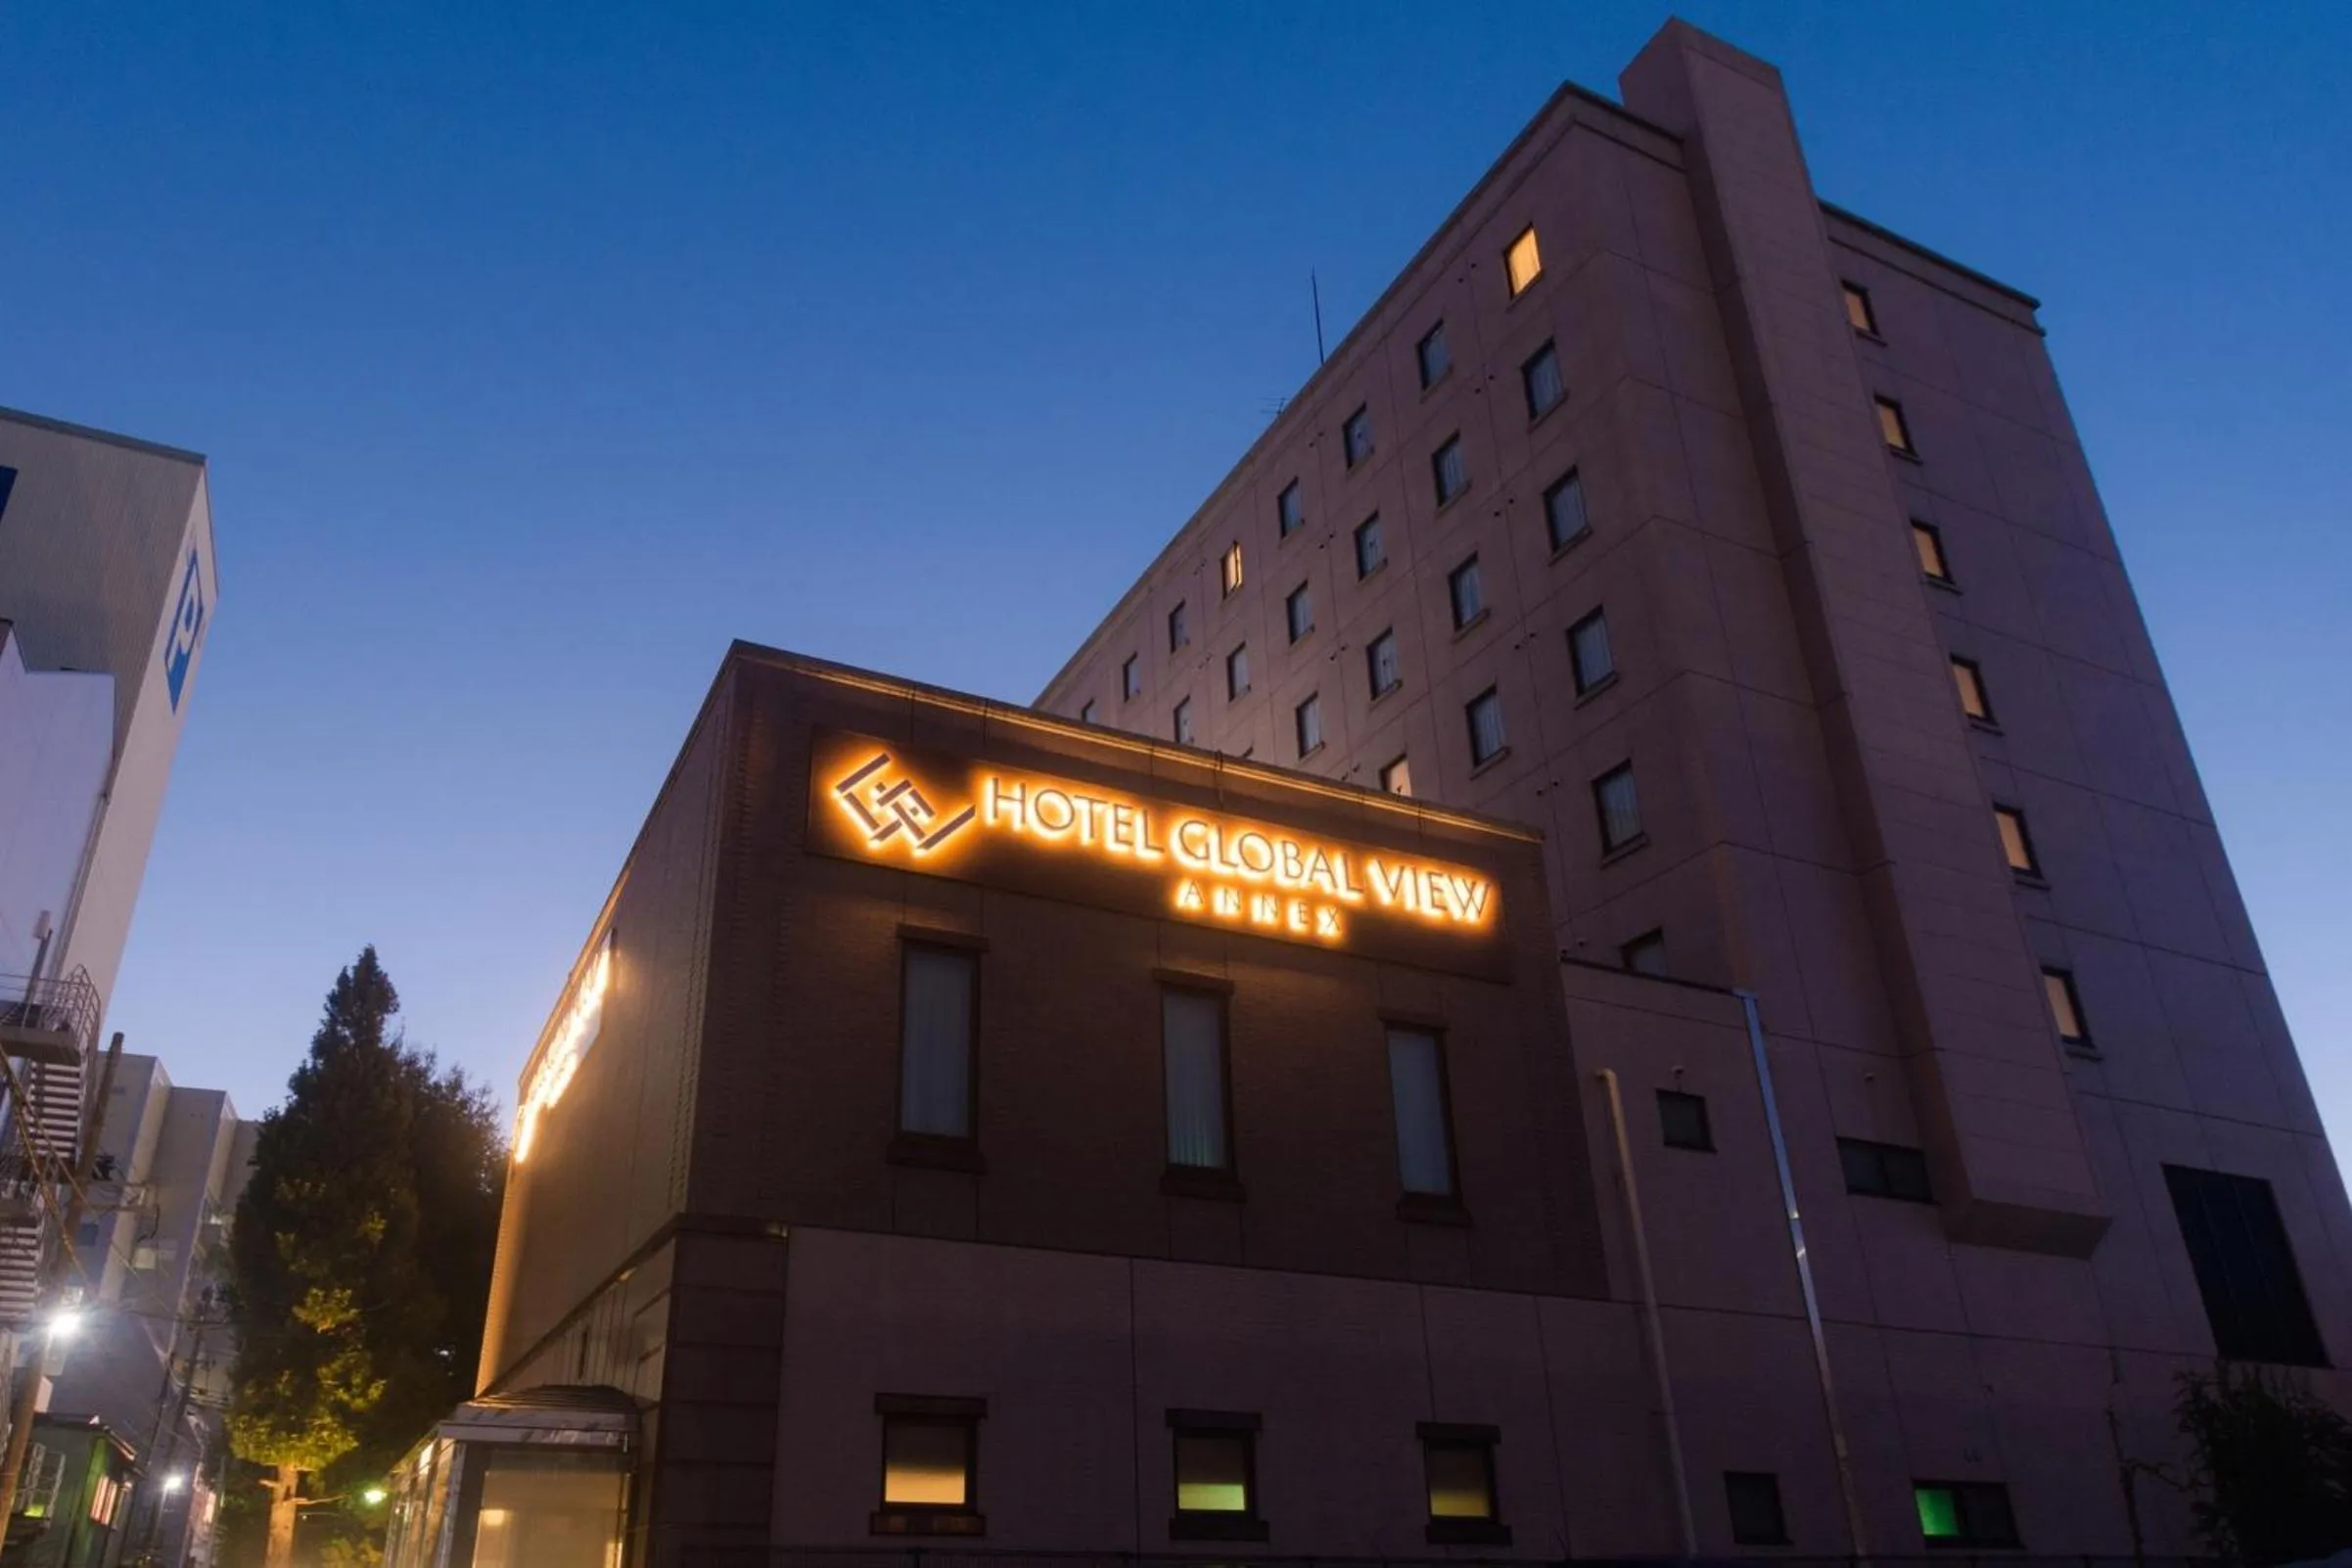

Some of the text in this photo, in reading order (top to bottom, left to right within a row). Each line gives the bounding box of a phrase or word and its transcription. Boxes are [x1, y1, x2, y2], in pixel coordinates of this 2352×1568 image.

[988, 776, 1493, 920] HOTEL GLOBAL VIEW
[1179, 879, 1342, 934] ANNEX
